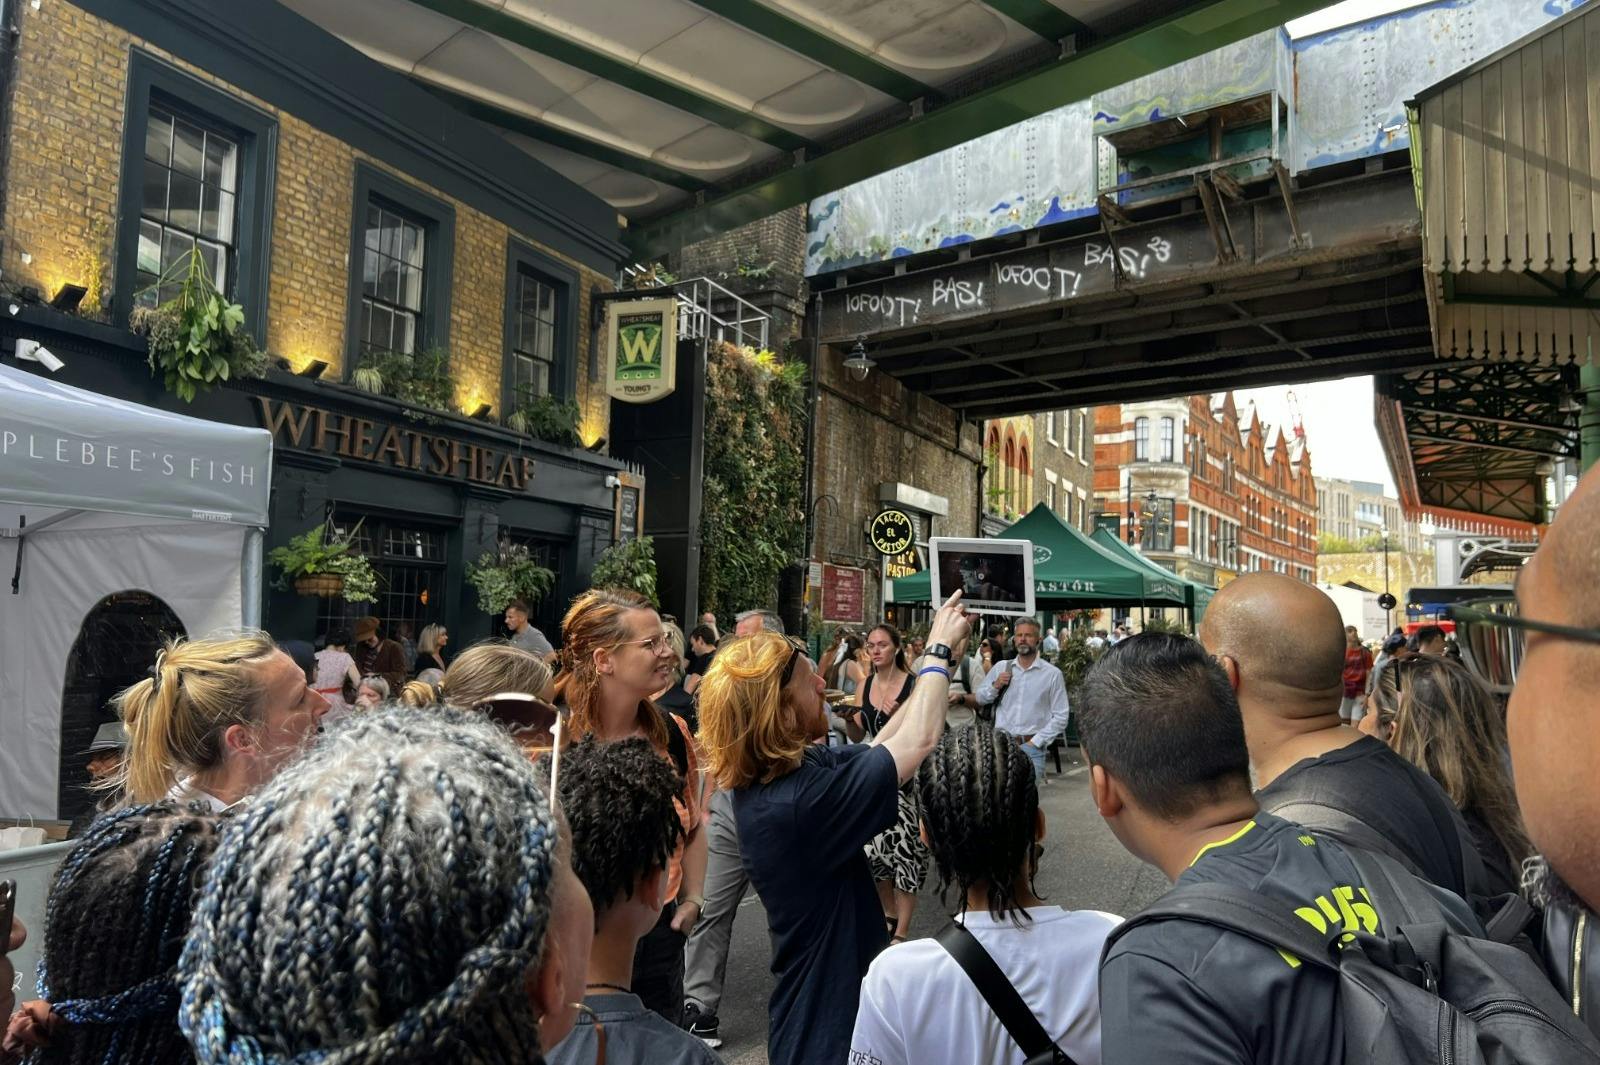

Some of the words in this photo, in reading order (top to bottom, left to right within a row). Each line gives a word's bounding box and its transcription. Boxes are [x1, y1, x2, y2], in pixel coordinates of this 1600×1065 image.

[932, 276, 983, 309] BAS!
[620, 328, 661, 364] W
[256, 395, 536, 491] WHEATSHEAF
[190, 457, 254, 487] FISH
[877, 512, 906, 525] TACOS
[886, 527, 896, 537] EL
[876, 538, 907, 550] PASTOR
